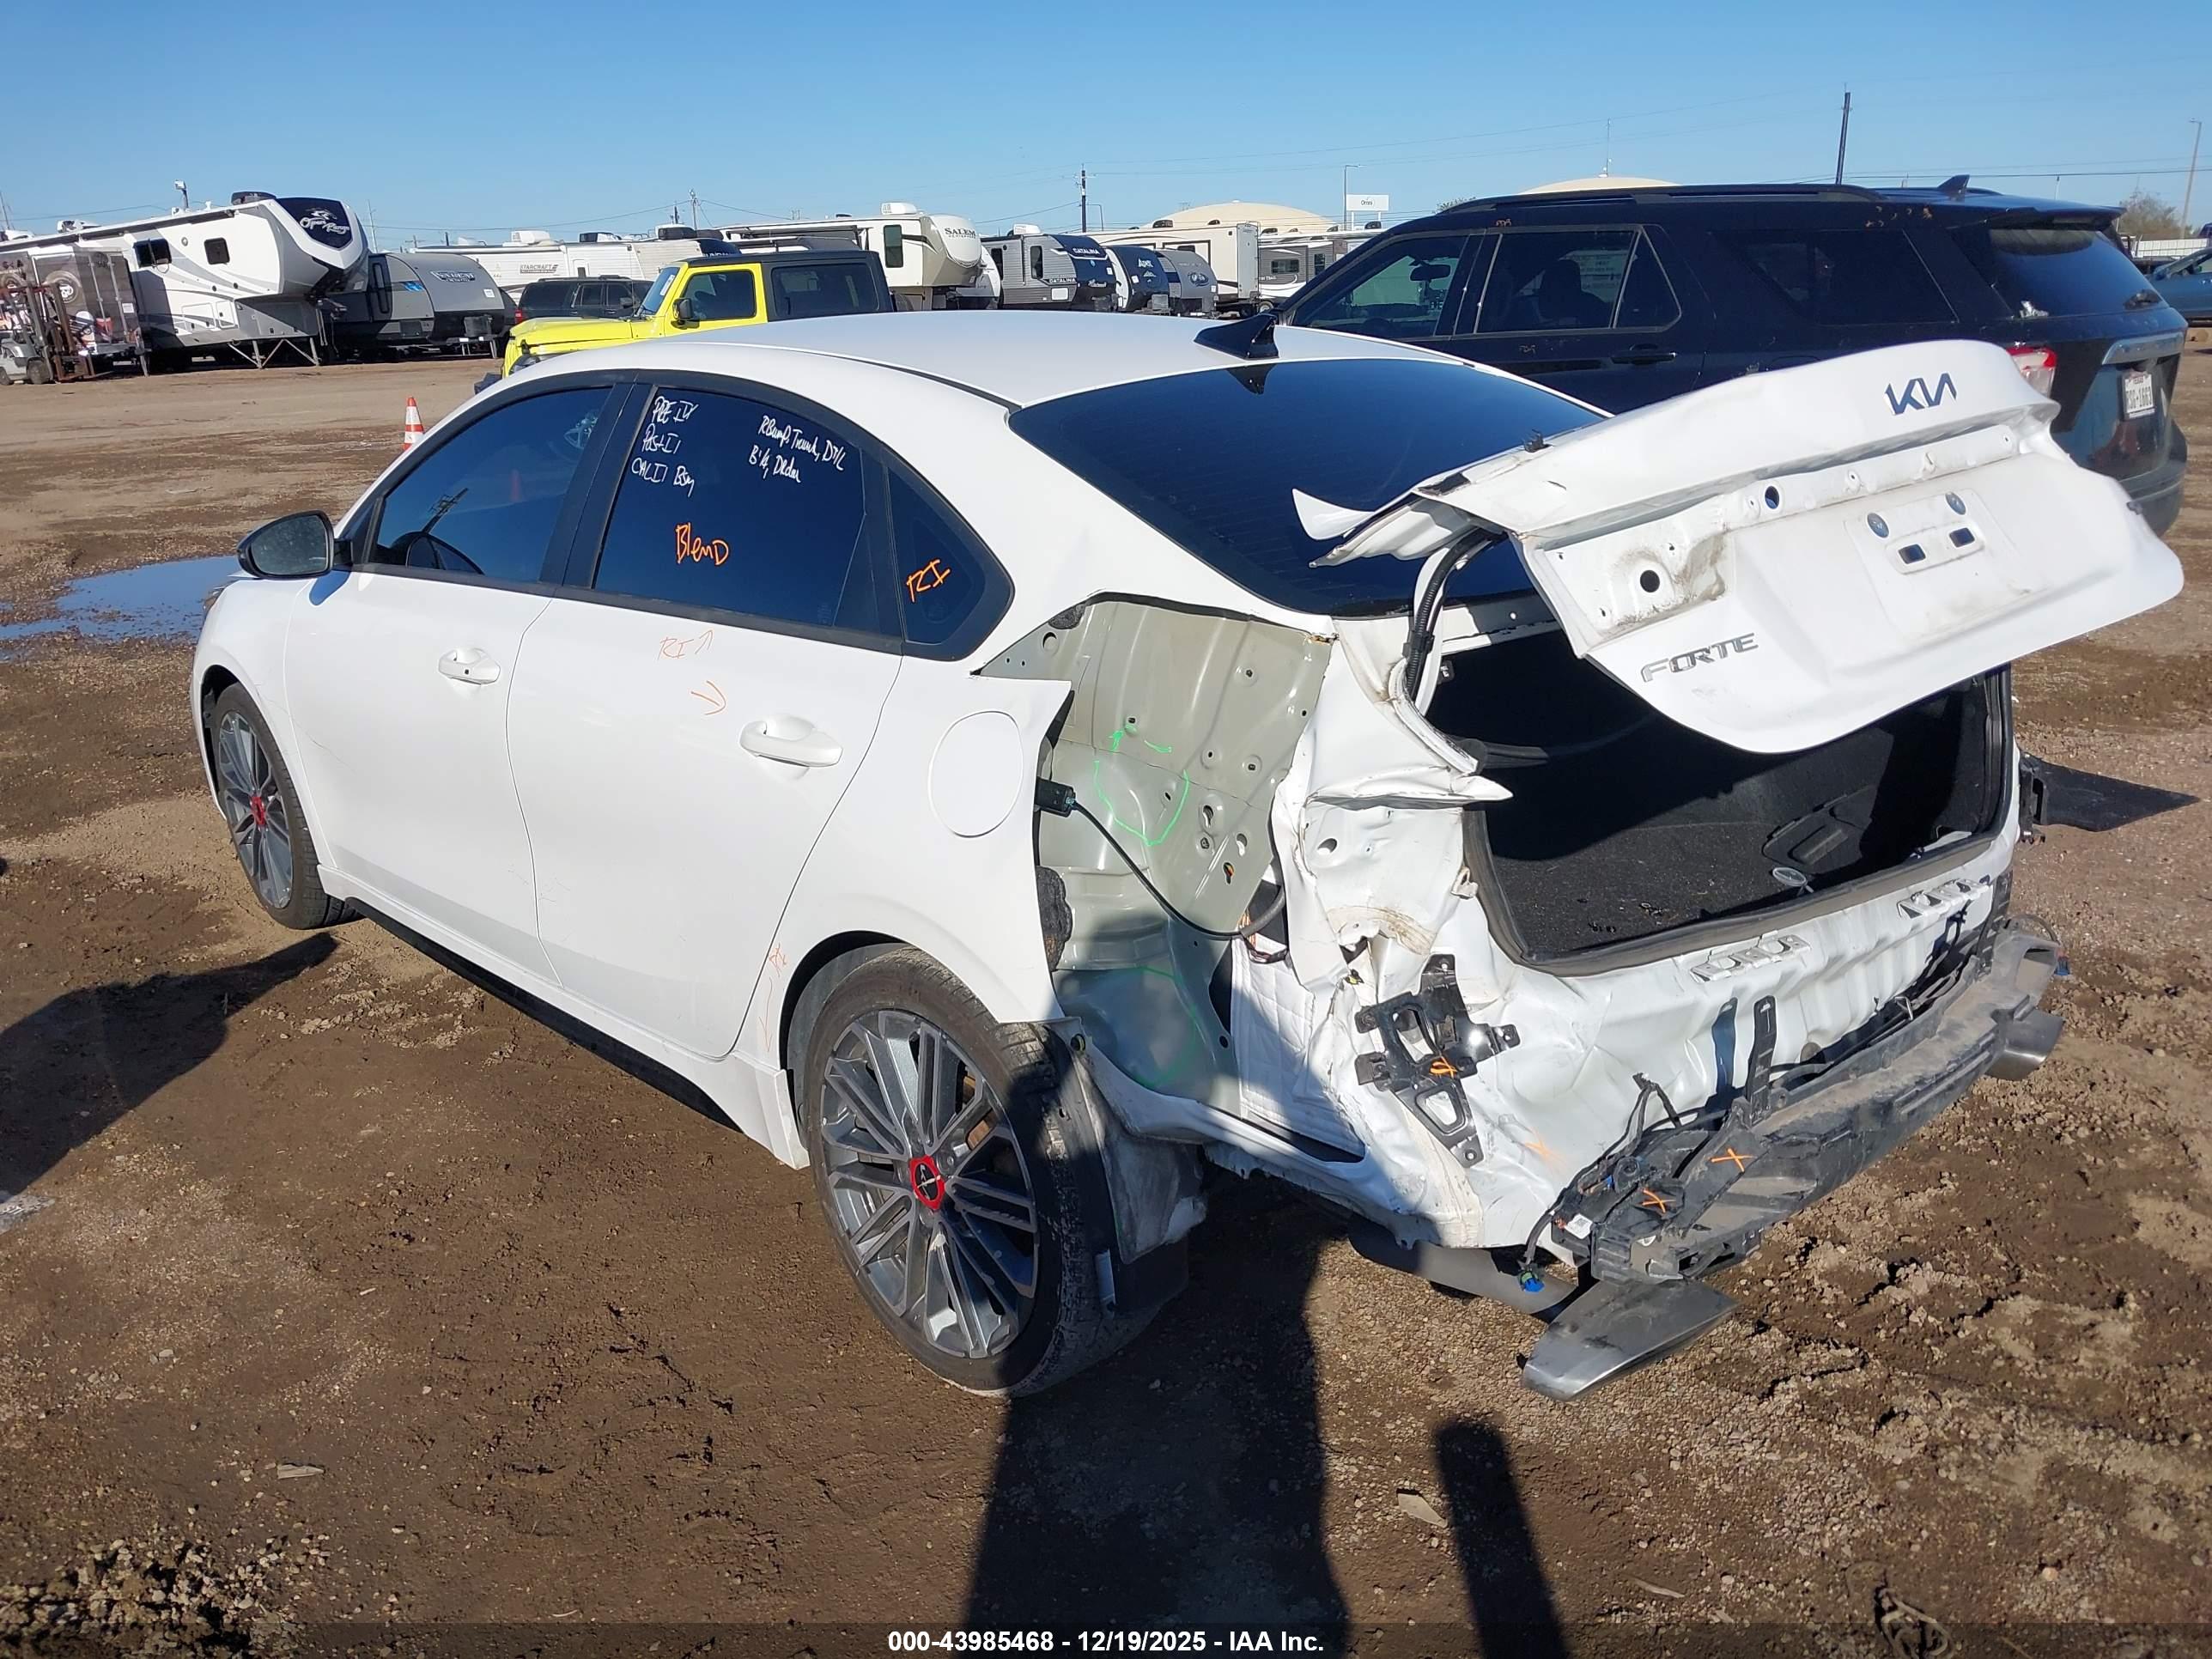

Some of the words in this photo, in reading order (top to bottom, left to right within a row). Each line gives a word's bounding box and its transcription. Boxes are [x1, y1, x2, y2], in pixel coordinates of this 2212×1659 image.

[945, 227, 975, 236] SALEM
[1884, 372, 1957, 415] KIA
[1641, 632, 1759, 683] FORTE
